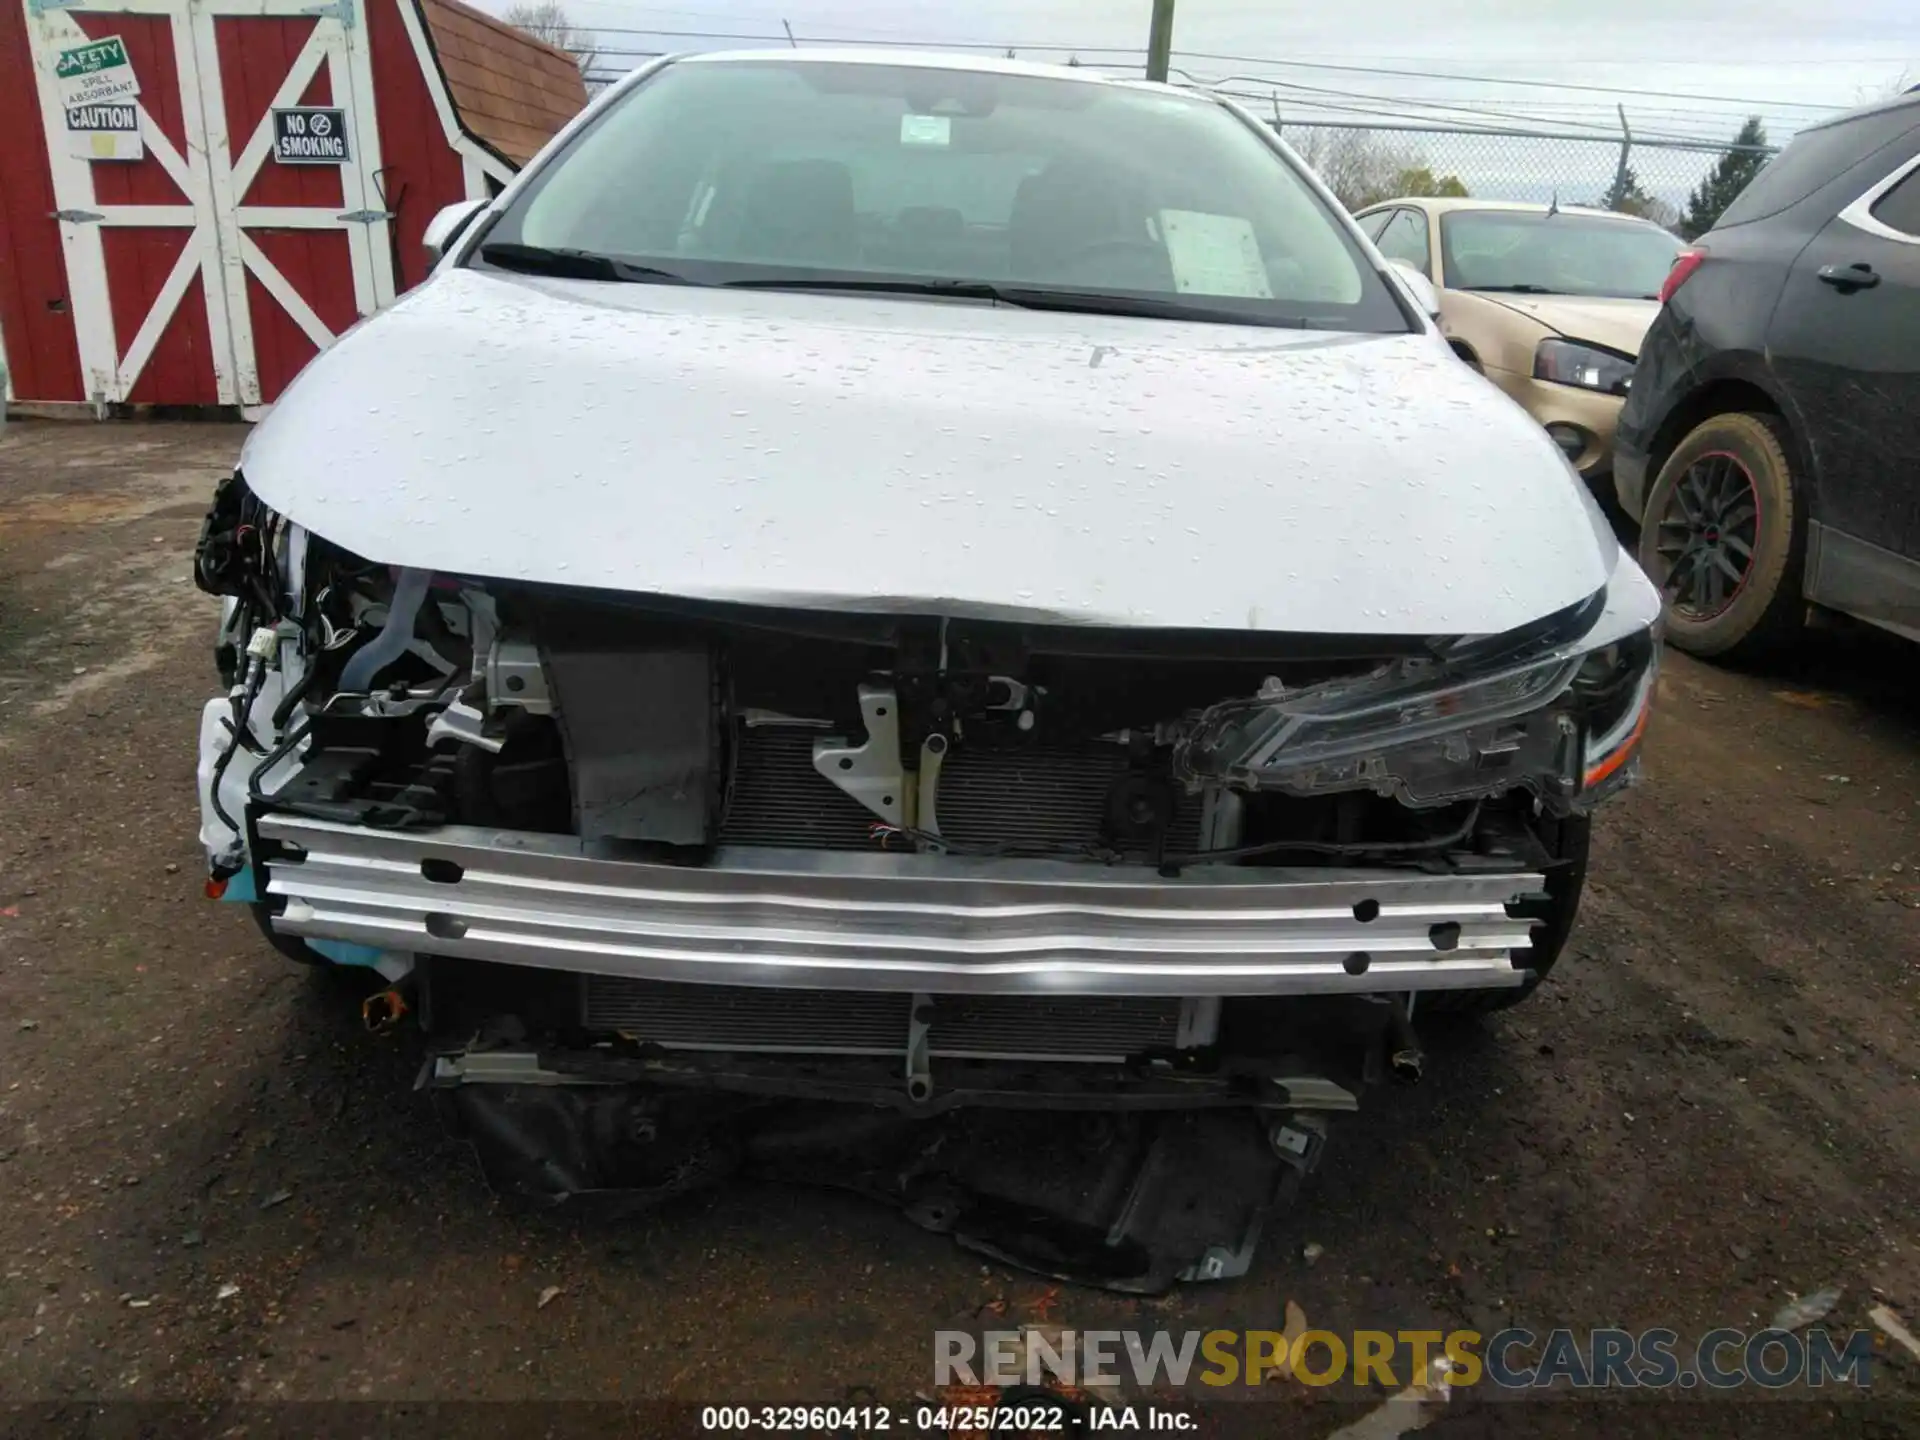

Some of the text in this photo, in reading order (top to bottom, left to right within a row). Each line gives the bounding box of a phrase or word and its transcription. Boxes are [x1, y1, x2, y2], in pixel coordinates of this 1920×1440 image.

[58, 43, 120, 72] SAFETY
[69, 81, 133, 103] ABSORBANT
[69, 107, 134, 128] CAUTION
[286, 114, 306, 134] NO
[281, 136, 344, 156] SMOKING
